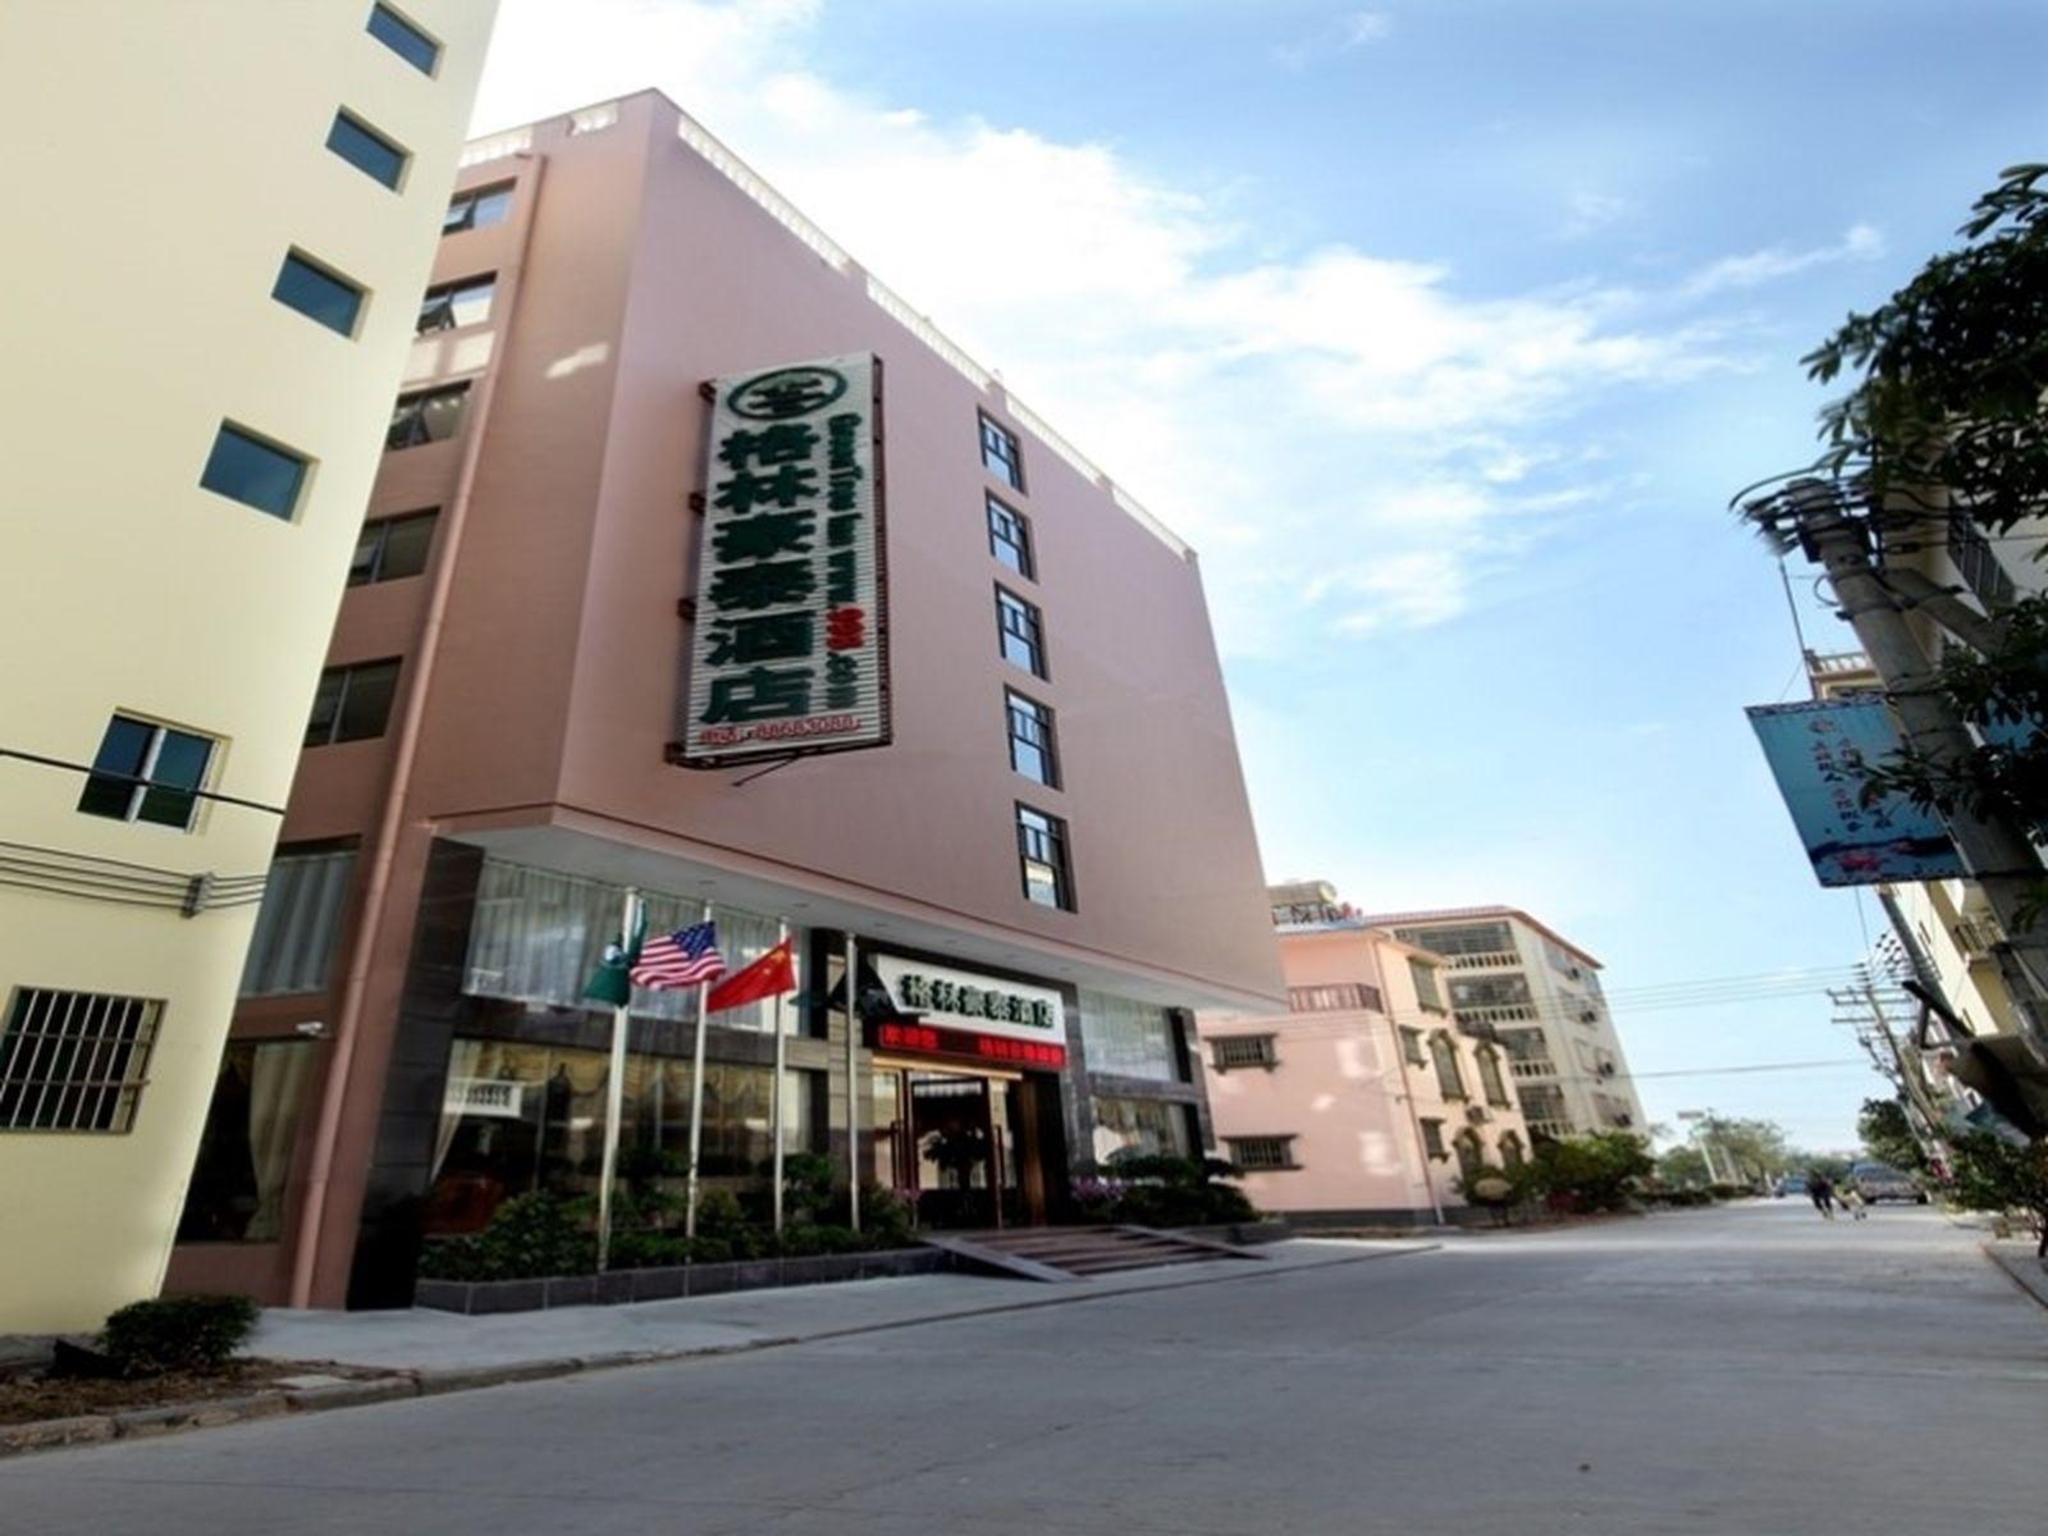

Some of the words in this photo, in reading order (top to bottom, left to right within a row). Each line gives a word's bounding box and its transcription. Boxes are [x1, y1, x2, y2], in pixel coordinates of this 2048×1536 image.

[699, 422, 820, 724] 格林豪泰酒店
[900, 973, 1054, 1029] 格林豪泰酒店
